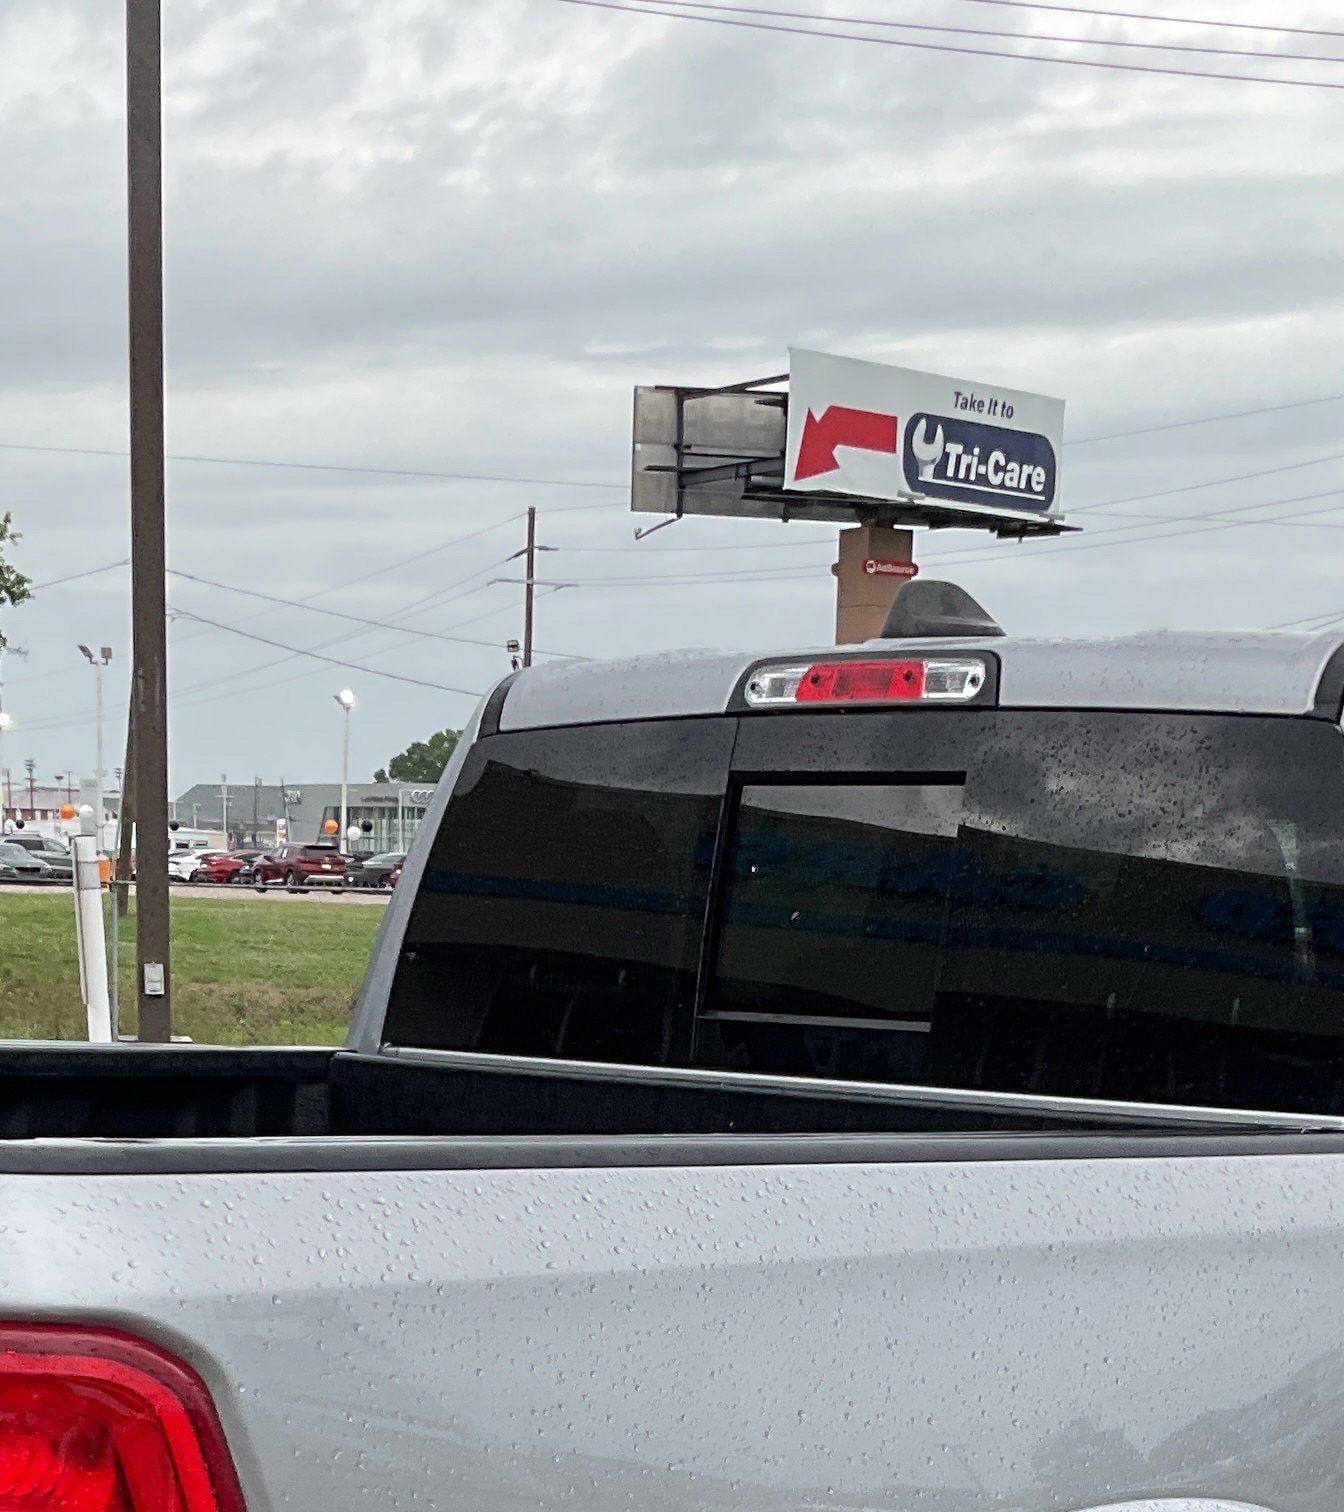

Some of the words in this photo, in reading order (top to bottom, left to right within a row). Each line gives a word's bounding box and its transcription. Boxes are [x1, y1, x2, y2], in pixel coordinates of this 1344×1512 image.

[954, 391, 984, 415] Take
[987, 397, 997, 416] It
[1001, 402, 1014, 419] to
[945, 442, 1046, 492] Tri-Care
